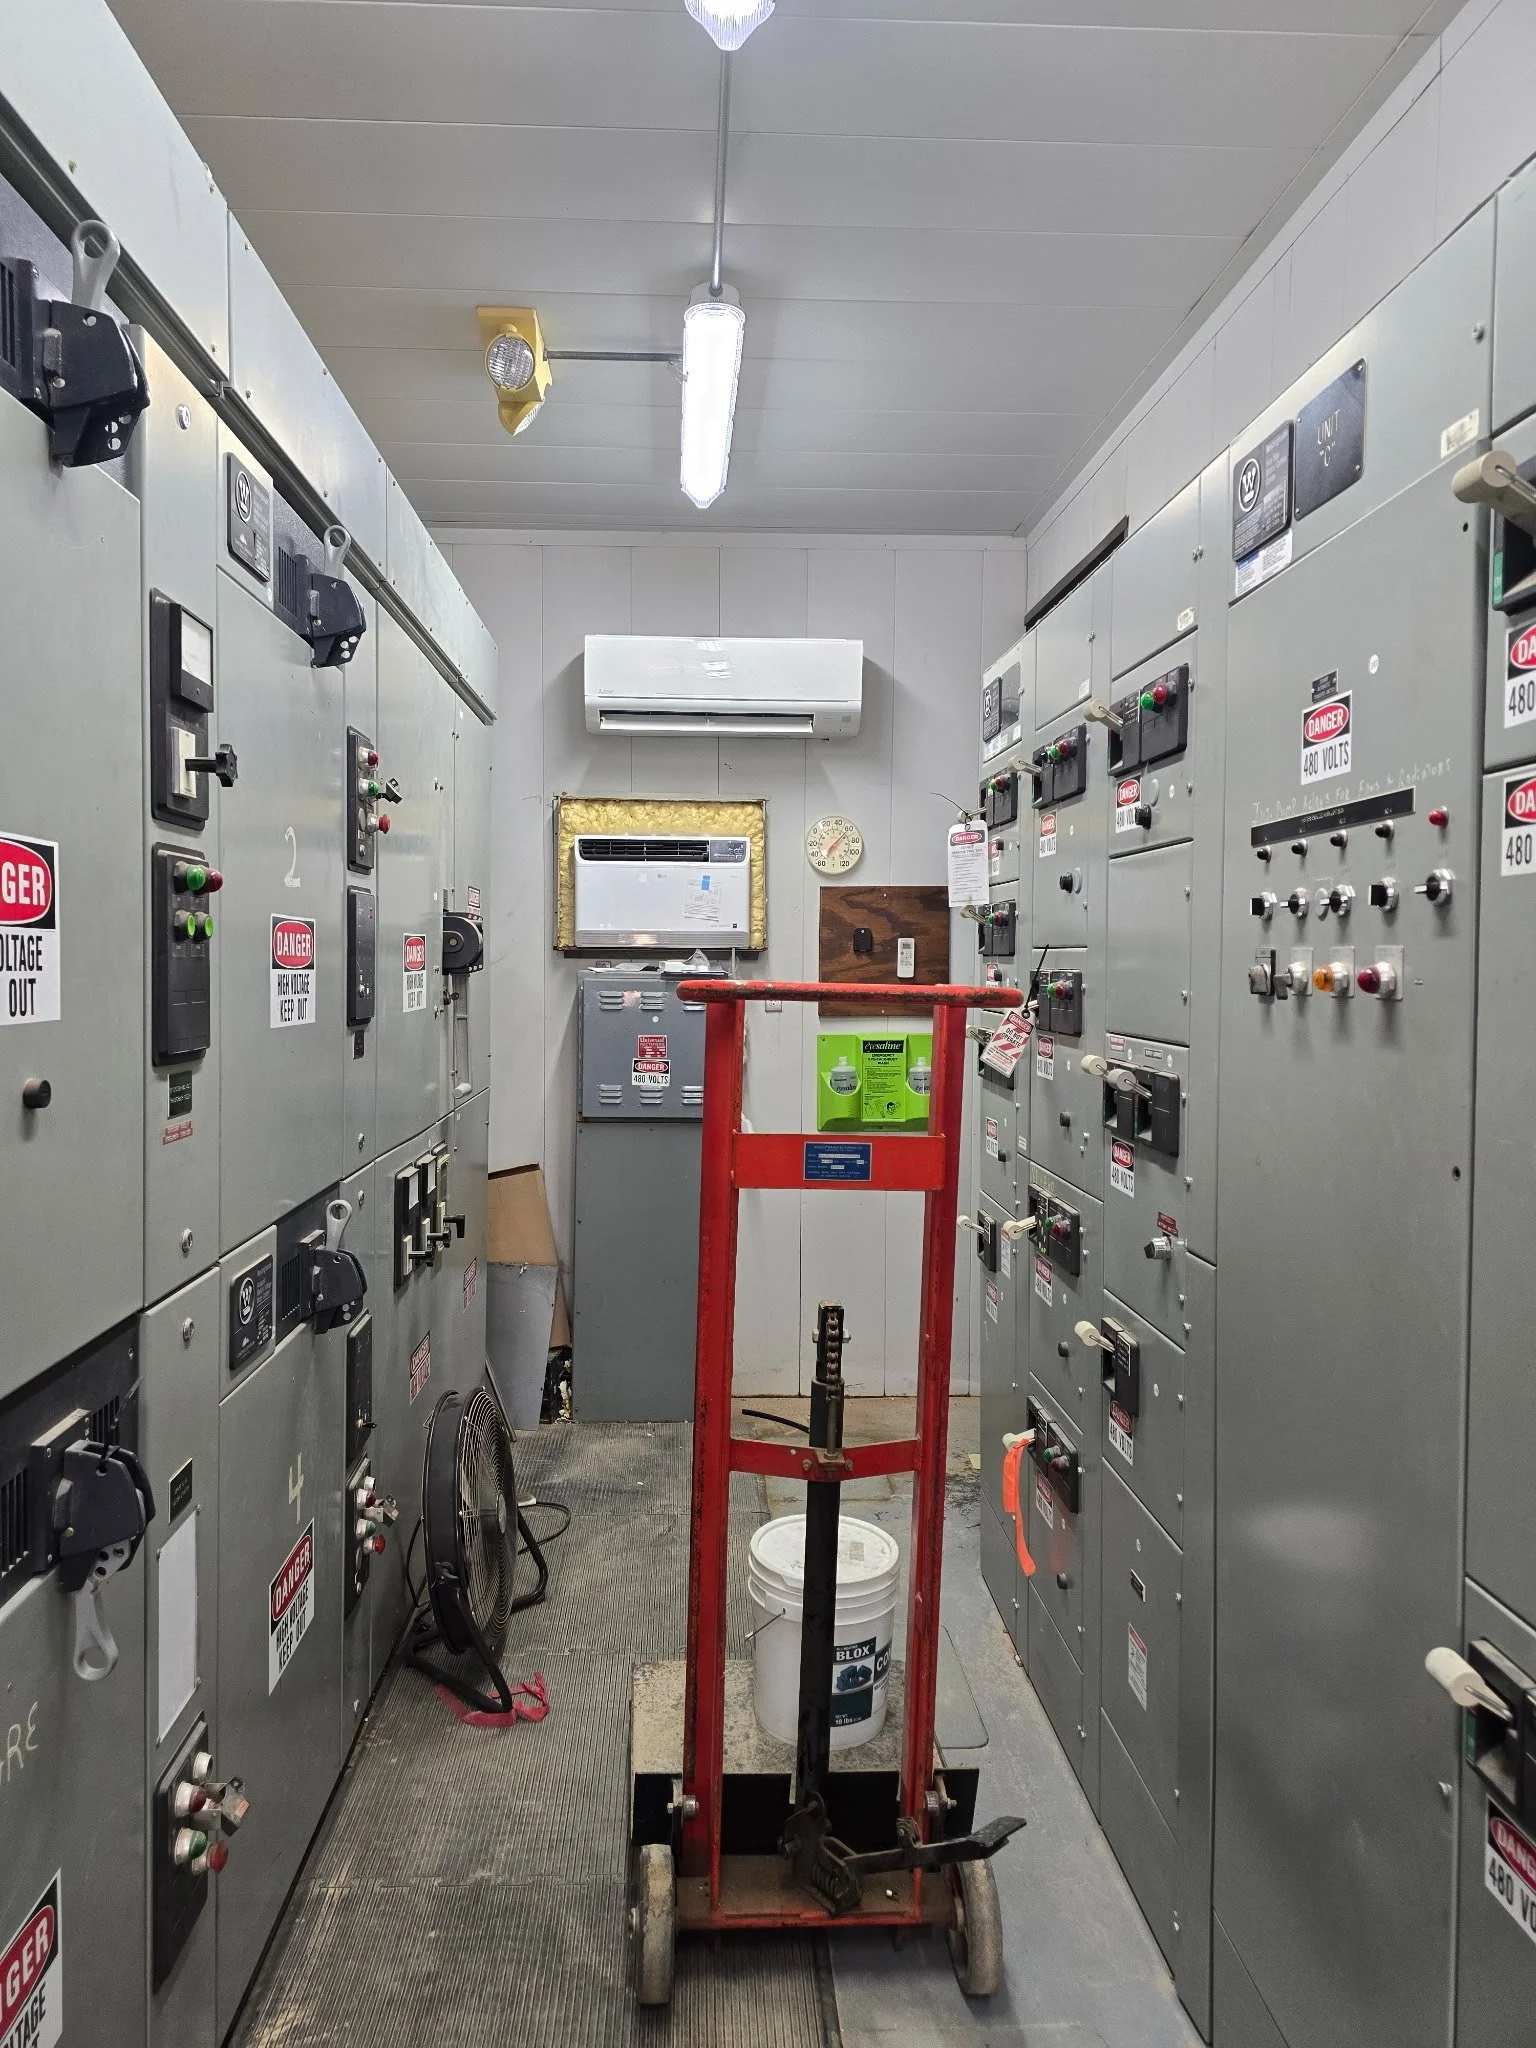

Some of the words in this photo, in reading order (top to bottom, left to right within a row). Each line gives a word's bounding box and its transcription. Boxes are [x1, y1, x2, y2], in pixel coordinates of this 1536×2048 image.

[1318, 409, 1340, 444] UNIT
[1509, 680, 1535, 717] 480
[1308, 708, 1344, 737] DANGER
[1304, 751, 1318, 777] 480
[1323, 741, 1350, 772] VOLTS
[1119, 784, 1138, 800] DANGER
[1515, 789, 1536, 815] DA
[285, 827, 301, 887] 2
[1506, 833, 1533, 867] 480
[277, 932, 312, 957] DANGER
[9, 978, 36, 1017] OUT
[278, 974, 289, 996] HIGH
[291, 974, 310, 995] VOLTAGE
[280, 998, 294, 1022] KEEP
[298, 998, 308, 1020] OUT
[1002, 1032, 1021, 1048] OPERATE
[634, 1075, 646, 1083] 480
[649, 1075, 669, 1085] VOLTS
[638, 1063, 665, 1071] DANGER
[1114, 1145, 1132, 1164] DANGER
[1120, 1170, 1134, 1193] VOLTS
[288, 1452, 304, 1524] 4
[276, 1541, 311, 1614] DANGER
[276, 1613, 289, 1652] HIGH
[289, 1579, 309, 1630] VOLTAGE
[279, 1632, 293, 1673] KEEP
[296, 1607, 307, 1644] OUT
[836, 1645, 870, 1661] BLOX
[877, 1647, 891, 1672] CO
[0, 1702, 38, 1785] RE
[1489, 1857, 1514, 1906] 480
[0, 1917, 49, 2024] GER
[3, 1982, 46, 2048] TAGE
